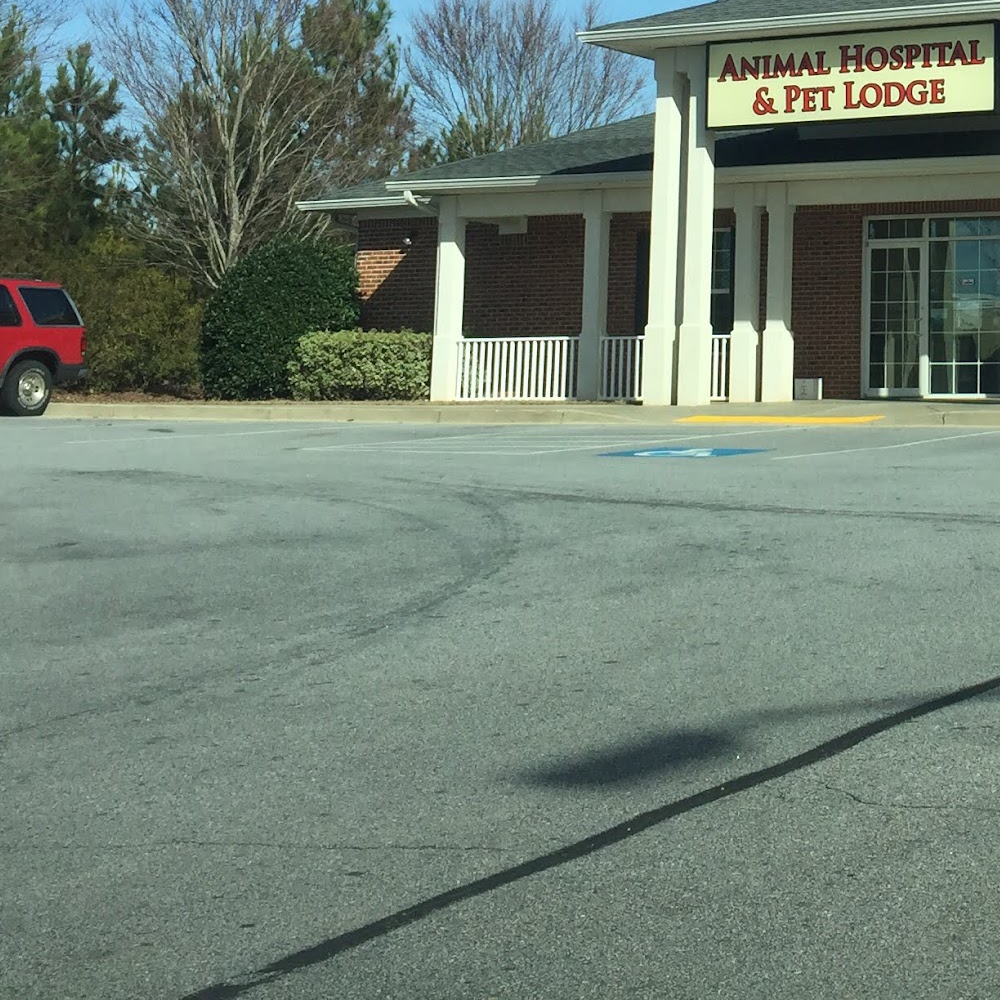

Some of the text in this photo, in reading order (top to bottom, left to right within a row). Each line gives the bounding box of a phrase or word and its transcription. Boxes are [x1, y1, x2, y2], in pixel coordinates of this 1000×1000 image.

[717, 40, 985, 82] ANIMAL HOSPITAL
[752, 79, 945, 115] & PET LODGE
